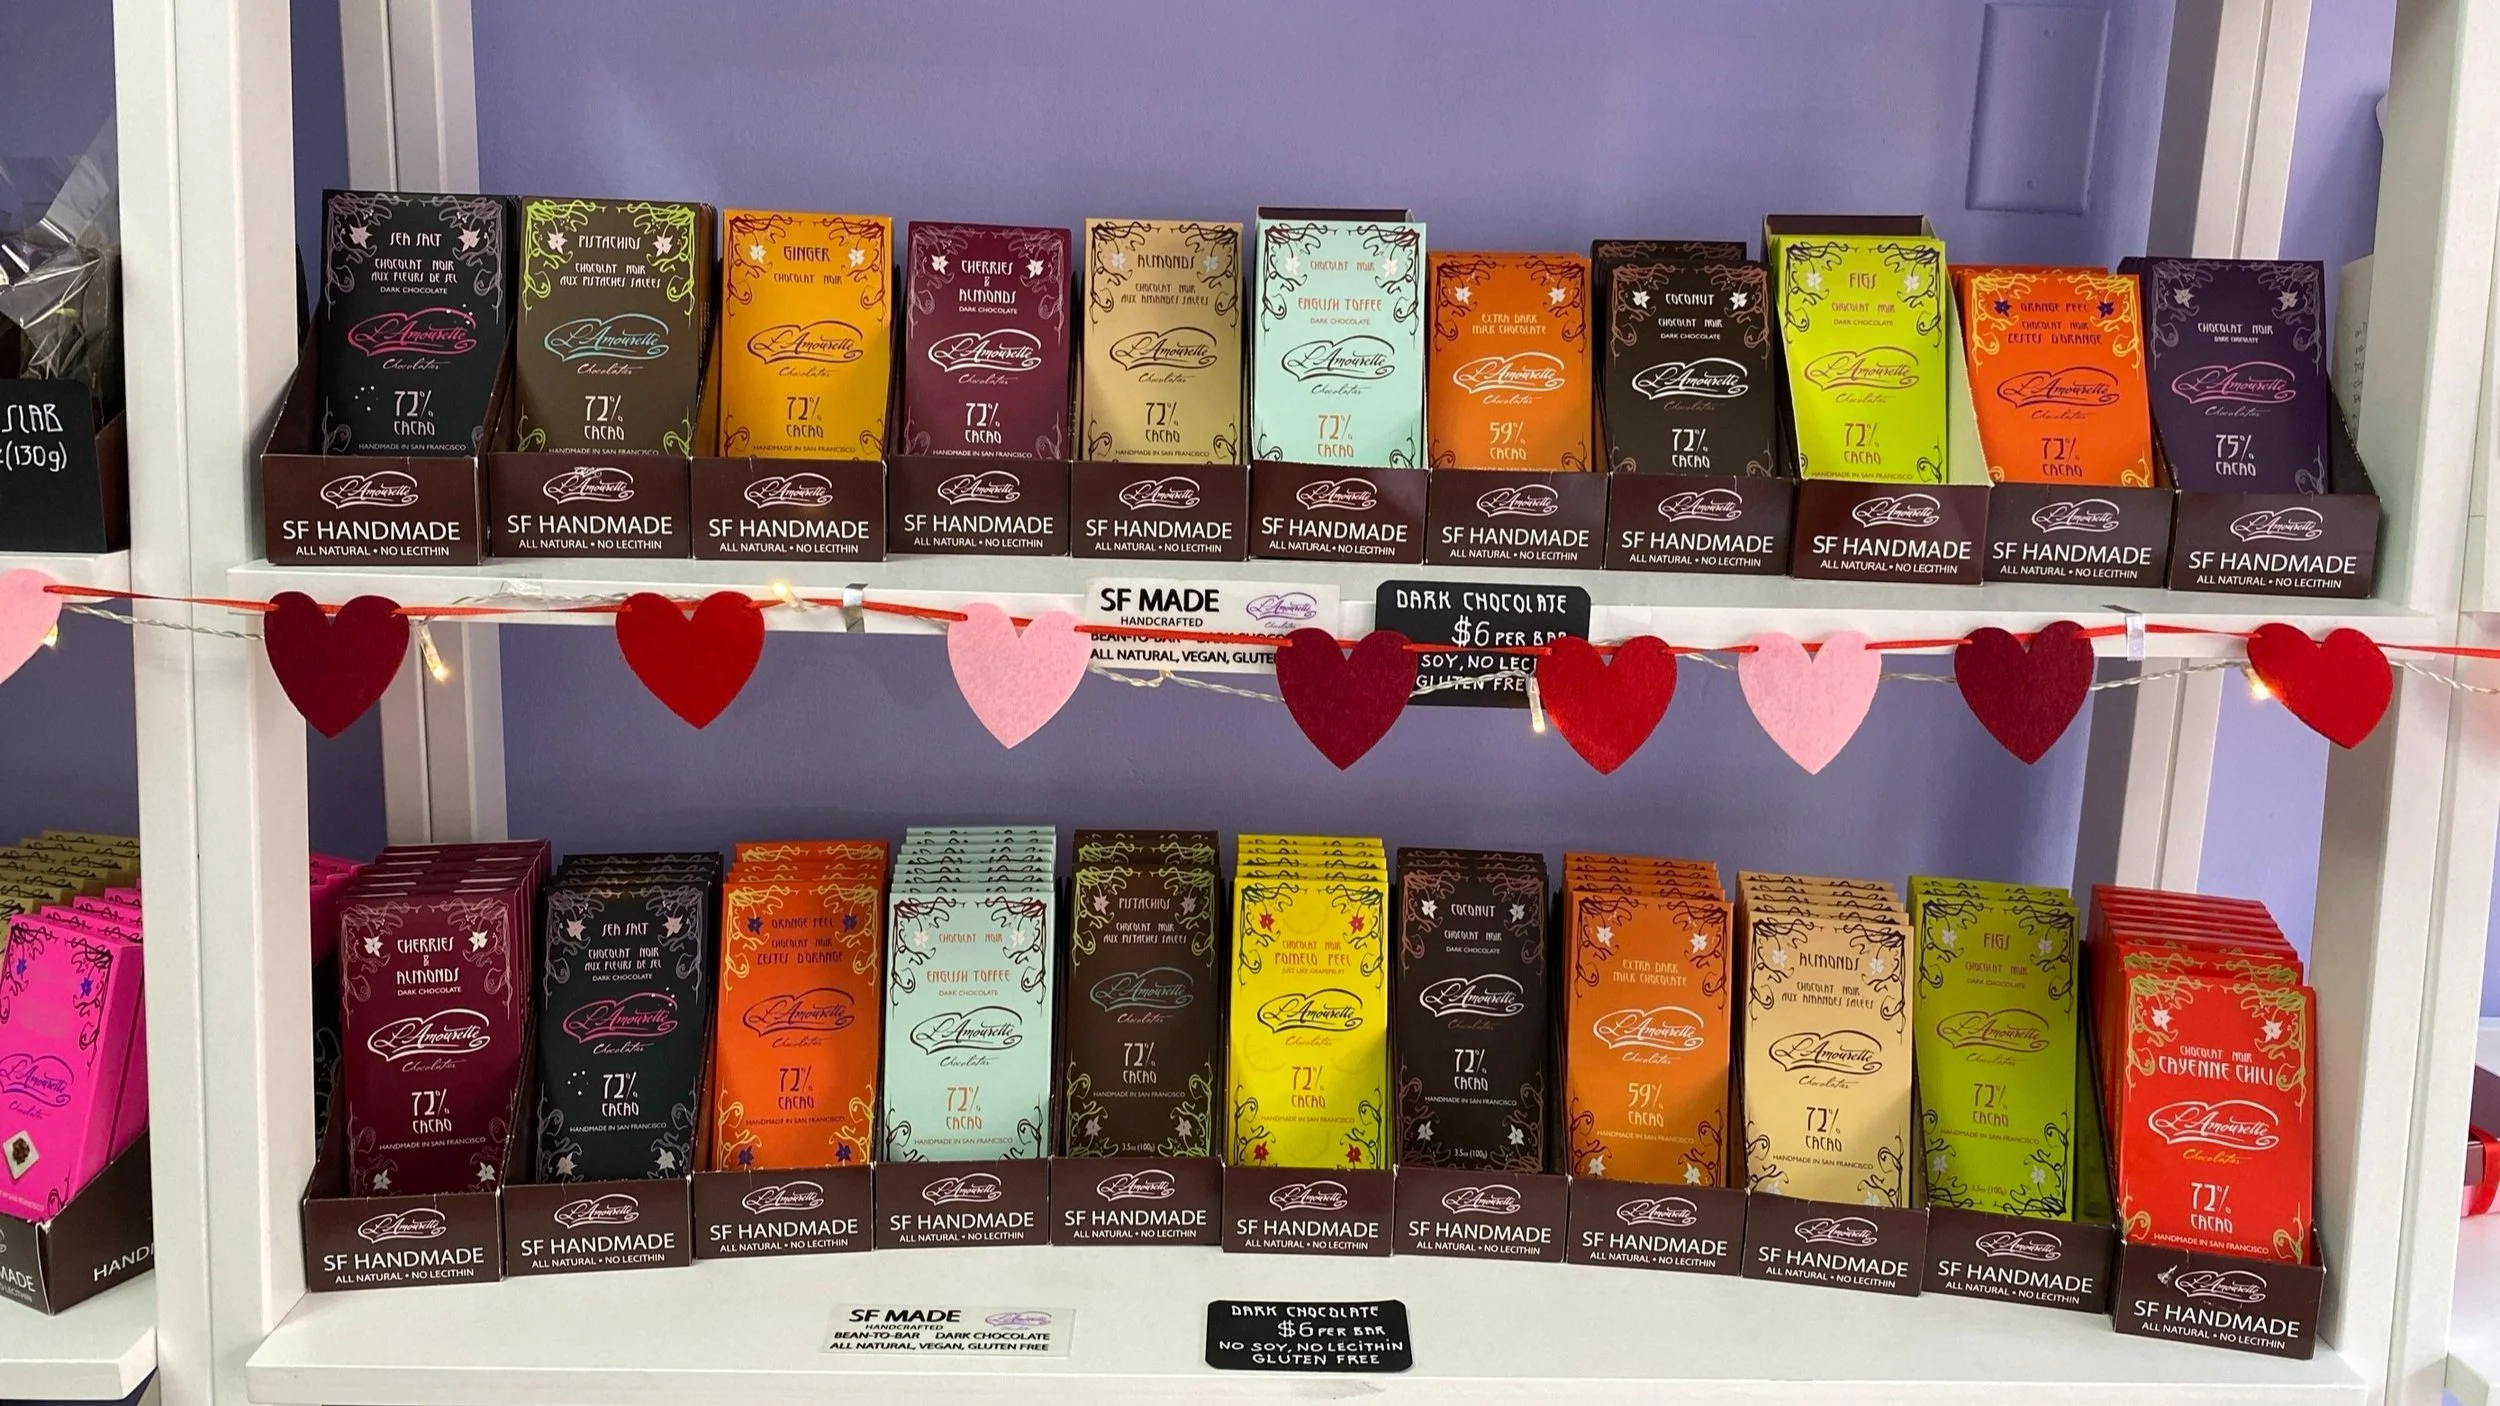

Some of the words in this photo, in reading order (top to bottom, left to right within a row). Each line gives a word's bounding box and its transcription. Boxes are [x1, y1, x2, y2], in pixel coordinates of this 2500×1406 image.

[579, 235, 640, 249] PISTACHIOS
[784, 246, 830, 262] GINGER
[1138, 255, 1195, 269] ALMONDS
[962, 260, 1013, 275] CHERRIES
[1850, 273, 1877, 289] FIGS
[960, 289, 1016, 303] ALMONDS
[1666, 294, 1714, 305] COCONUT
[1298, 298, 1339, 311] ENGLISH
[1345, 299, 1381, 311] TOFFEE
[2021, 302, 2060, 312] ORANGE
[2066, 303, 2087, 312] PEEL
[1499, 324, 1545, 334] CHOCOLATE
[2198, 323, 2242, 333] CHOCOLAT
[2252, 325, 2273, 334] NOIR
[395, 390, 433, 416] 72%
[2, 404, 63, 433] SLAB
[394, 421, 435, 435] CACAO
[1490, 422, 1525, 444] 59%
[1490, 448, 1526, 460] CACAO
[2216, 435, 2254, 460] 75%
[2216, 462, 2256, 476] CACAO
[283, 521, 308, 539] SF
[317, 521, 460, 540] HANDMADE
[508, 515, 531, 533] SF
[540, 516, 672, 534] HANDMADE
[709, 519, 732, 537] SF
[740, 520, 869, 538] HANDMADE
[905, 514, 926, 531] SF
[934, 515, 1053, 533] HANDMADE
[1087, 519, 1108, 536] SF
[1115, 520, 1232, 539] HANDMADE
[1262, 517, 1284, 534] SF
[1290, 519, 1407, 542] HANDMADE
[1442, 527, 1464, 543] SF
[1470, 528, 1589, 547] HANDMADE
[1622, 531, 1645, 548] SF
[1651, 532, 1773, 553] HANDMADE
[296, 546, 316, 555] ALL
[319, 546, 370, 555] NATURAL
[381, 546, 398, 555] NO
[401, 546, 449, 556] LECITHIN
[1813, 536, 1838, 553] SF
[1843, 537, 1971, 559] HANDMADE
[1993, 542, 2017, 559] SF
[2023, 543, 2152, 564] HANDMADE
[2189, 551, 2215, 569] SF
[2221, 553, 2356, 574] HANDMADE
[1101, 588, 1131, 611] SF
[1139, 589, 1219, 612] MADE
[1397, 590, 1451, 609] DARK
[1464, 592, 1566, 613] CHOCOLATE
[1121, 617, 1203, 627] HANDCRAFTED
[1495, 631, 1526, 646] PER
[1090, 649, 1114, 660] ALL
[1117, 649, 1179, 663] NATURAL,
[1182, 651, 1229, 664] VEGAN,
[1232, 652, 1278, 664] GLUTE
[1467, 655, 1494, 669] NO
[1493, 677, 1525, 692] FRE
[1119, 898, 1170, 909] PISTACHIOS
[1451, 904, 1495, 917] COCONUT
[772, 918, 808, 929] ORANGE
[813, 917, 834, 928] PEEL
[398, 937, 453, 953] CHERRIES
[1984, 933, 2011, 950] FIGS
[1275, 952, 1317, 965] POMELO
[1328, 954, 1350, 966] PEEL
[1623, 960, 1650, 971] EXTRA
[1655, 962, 1678, 974] DARK
[1800, 953, 1859, 971] ALMONDS
[397, 968, 459, 984] ALMONDS
[927, 971, 968, 983] ENGLISH
[973, 970, 1009, 982] TOFFEE
[1613, 972, 1635, 982] MILK
[1640, 974, 1686, 987] CHOCOLATE
[2159, 1056, 2229, 1080] CAYENNE
[2235, 1065, 2272, 1085] CHILI
[2192, 1183, 2230, 1213] 72%
[891, 1215, 911, 1230] SF
[918, 1212, 1033, 1229] HANDMADE
[1065, 1211, 1085, 1225] SF
[1092, 1210, 1206, 1225] HANDMADE
[2191, 1214, 2232, 1233] CACAO
[710, 1225, 731, 1240] SF
[739, 1219, 857, 1239] HANDMADE
[1237, 1219, 1258, 1234] SF
[1264, 1220, 1378, 1238] HANDMADE
[1409, 1221, 1430, 1236] SF
[1436, 1222, 1551, 1243] HANDMADE
[521, 1240, 543, 1256] SF
[551, 1233, 674, 1254] HANDMADE
[1583, 1232, 1604, 1247] SF
[1610, 1233, 1727, 1256] HANDMADE
[93, 1242, 155, 1281] HAND
[324, 1255, 347, 1271] SF
[355, 1248, 484, 1269] HANDMADE
[1759, 1247, 1781, 1262] SF
[1785, 1250, 1908, 1280] HANDMADE
[1938, 1261, 1961, 1276] SF
[1965, 1264, 2093, 1295] HANDMADE
[849, 1309, 880, 1322] SF
[885, 1310, 961, 1322] MADE
[1232, 1305, 1277, 1316] DARK
[1287, 1306, 1378, 1318] CHOCOLATE
[2134, 1300, 2159, 1317] SF
[2163, 1304, 2300, 1341] HANDMADE
[834, 1331, 920, 1339] BEAN-TO-BAR
[935, 1332, 971, 1340] DARK
[973, 1332, 1050, 1340] CHOCOLATE
[1318, 1328, 1346, 1336] PER
[1354, 1326, 1385, 1335] BAR
[2142, 1322, 2160, 1331] ALL
[2163, 1325, 2209, 1338] NATURAL
[2220, 1333, 2236, 1342] NO
[2239, 1336, 2285, 1349] LECITHIN
[1019, 1343, 1049, 1351] FREE
[1220, 1341, 1244, 1350] NO
[1297, 1343, 1326, 1352] NO
[1253, 1354, 1326, 1365] GLUTEN
[1337, 1355, 1379, 1364] FREE
